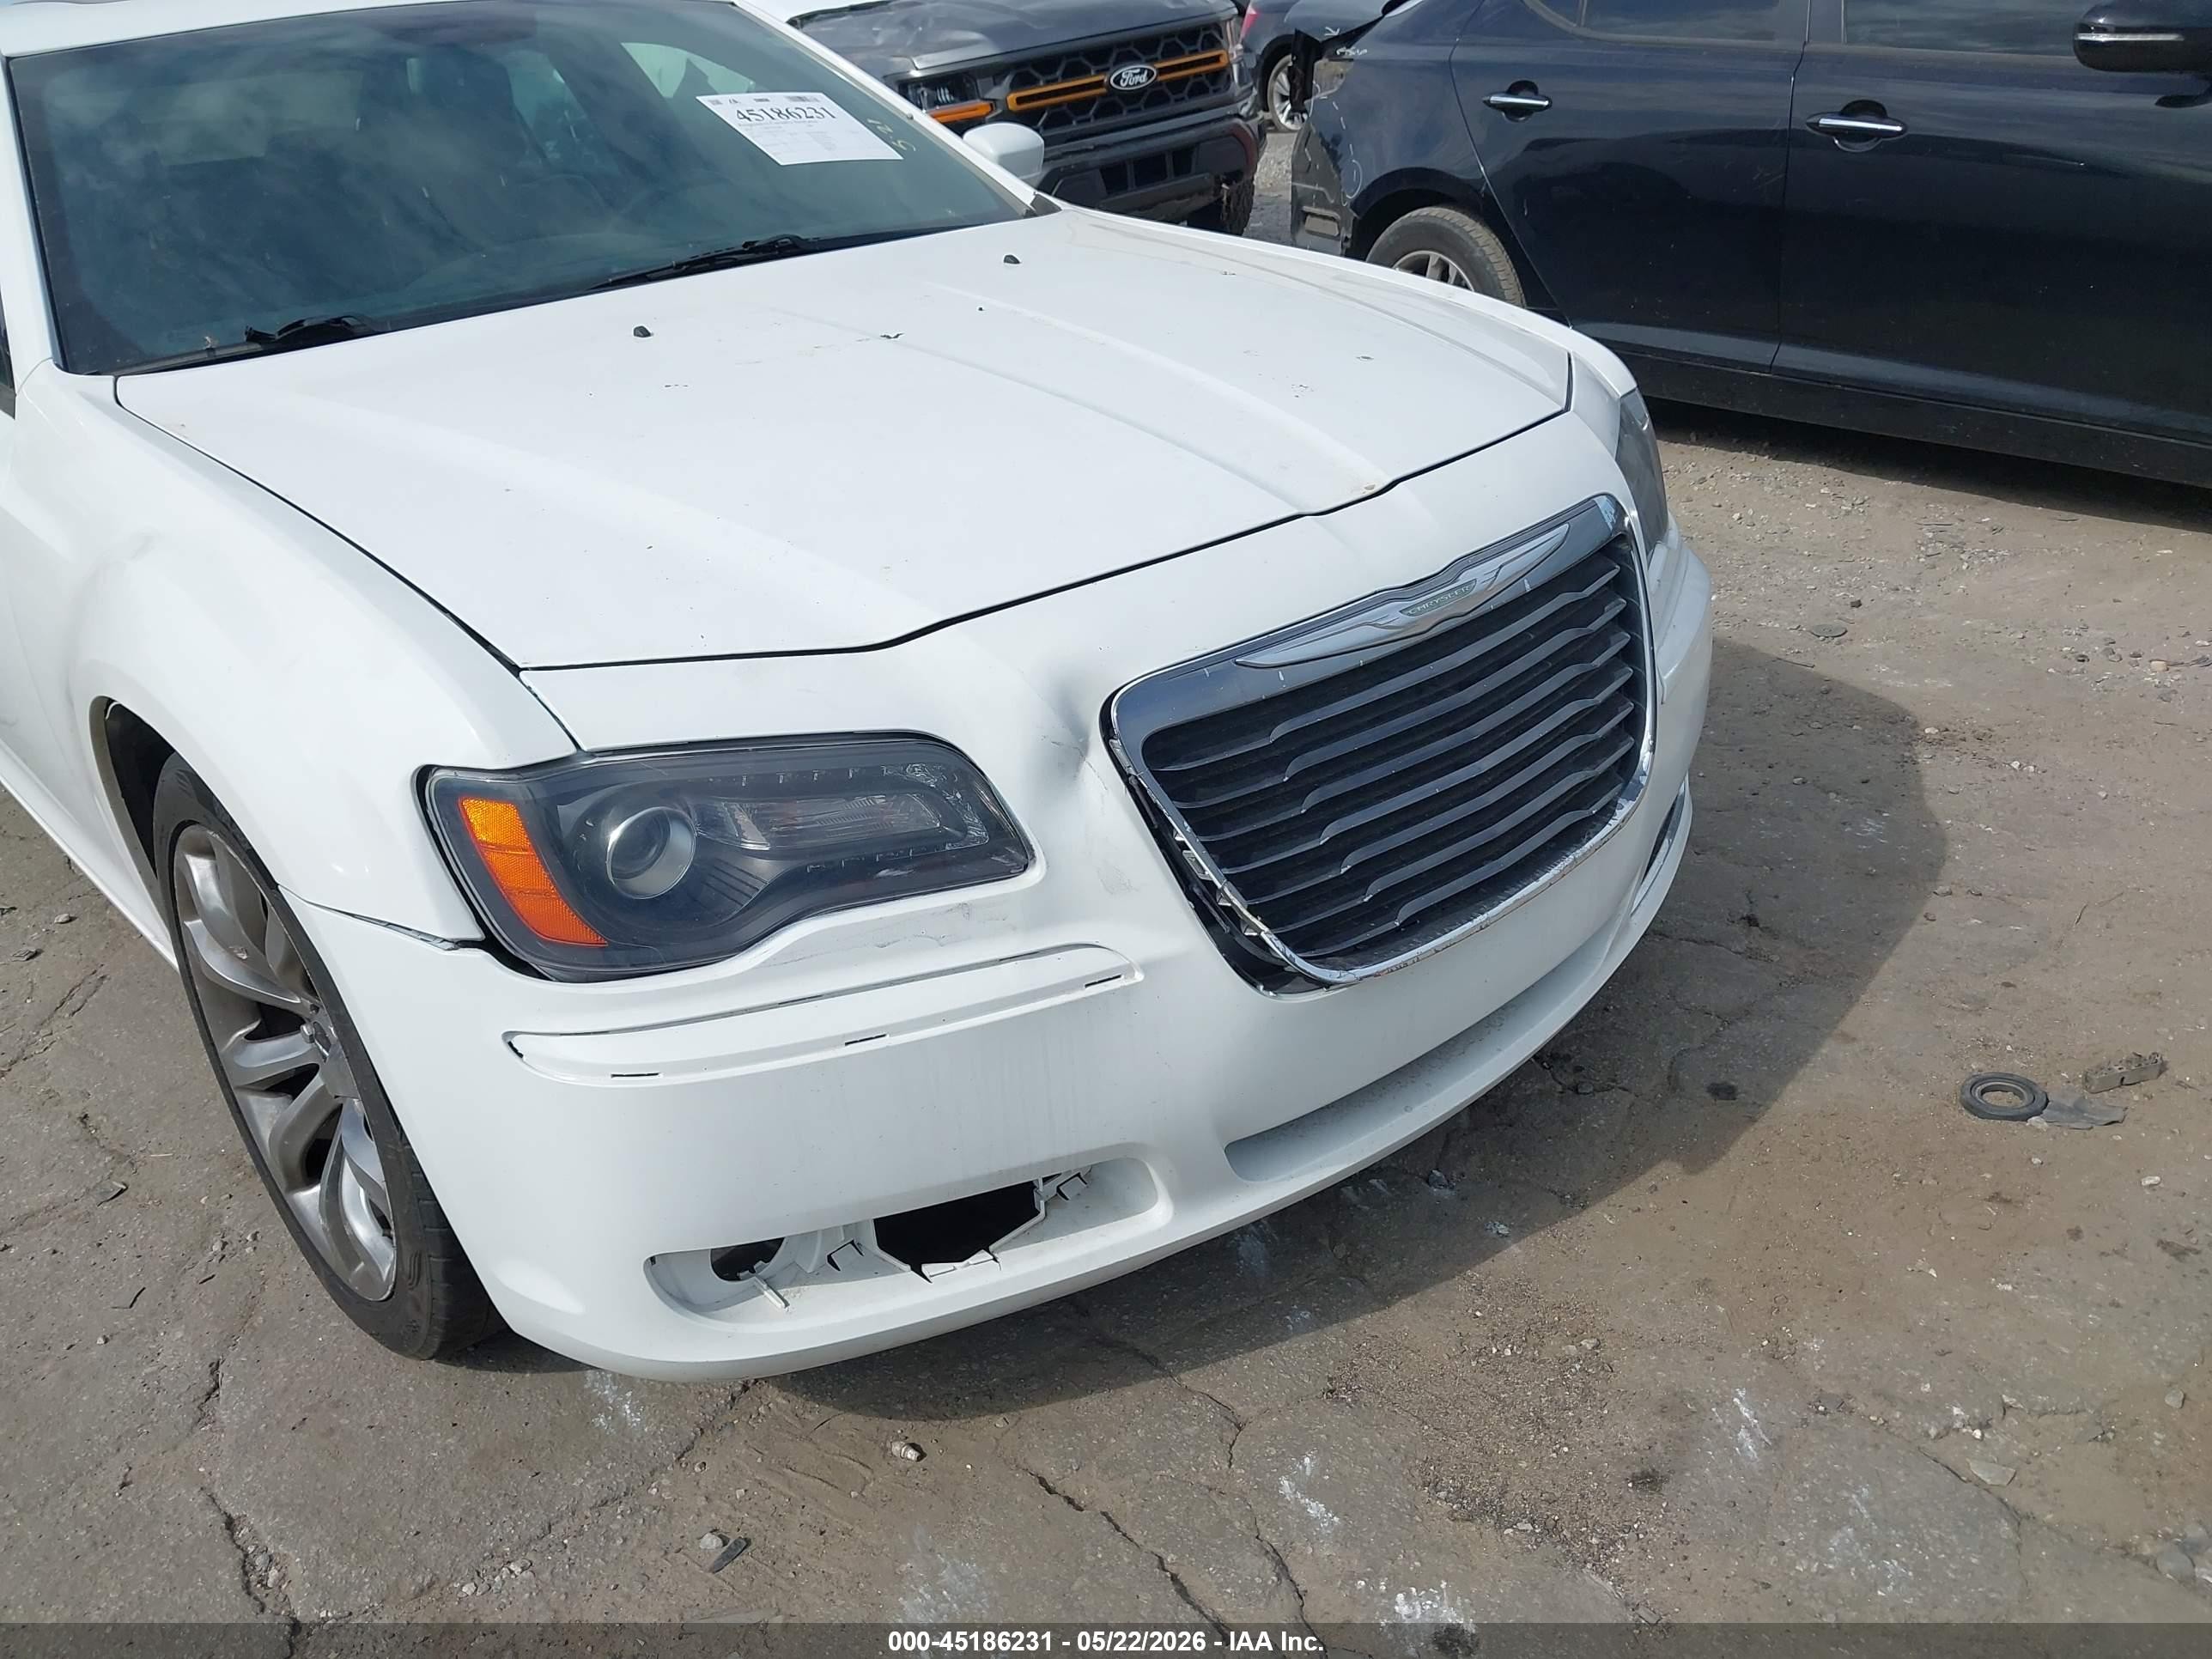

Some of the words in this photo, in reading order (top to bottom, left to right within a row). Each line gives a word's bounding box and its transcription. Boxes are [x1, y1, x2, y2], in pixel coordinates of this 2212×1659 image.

[1119, 68, 1148, 88] Ford
[735, 106, 836, 123] 45186231
[1407, 584, 1471, 615] CHRYSLER
